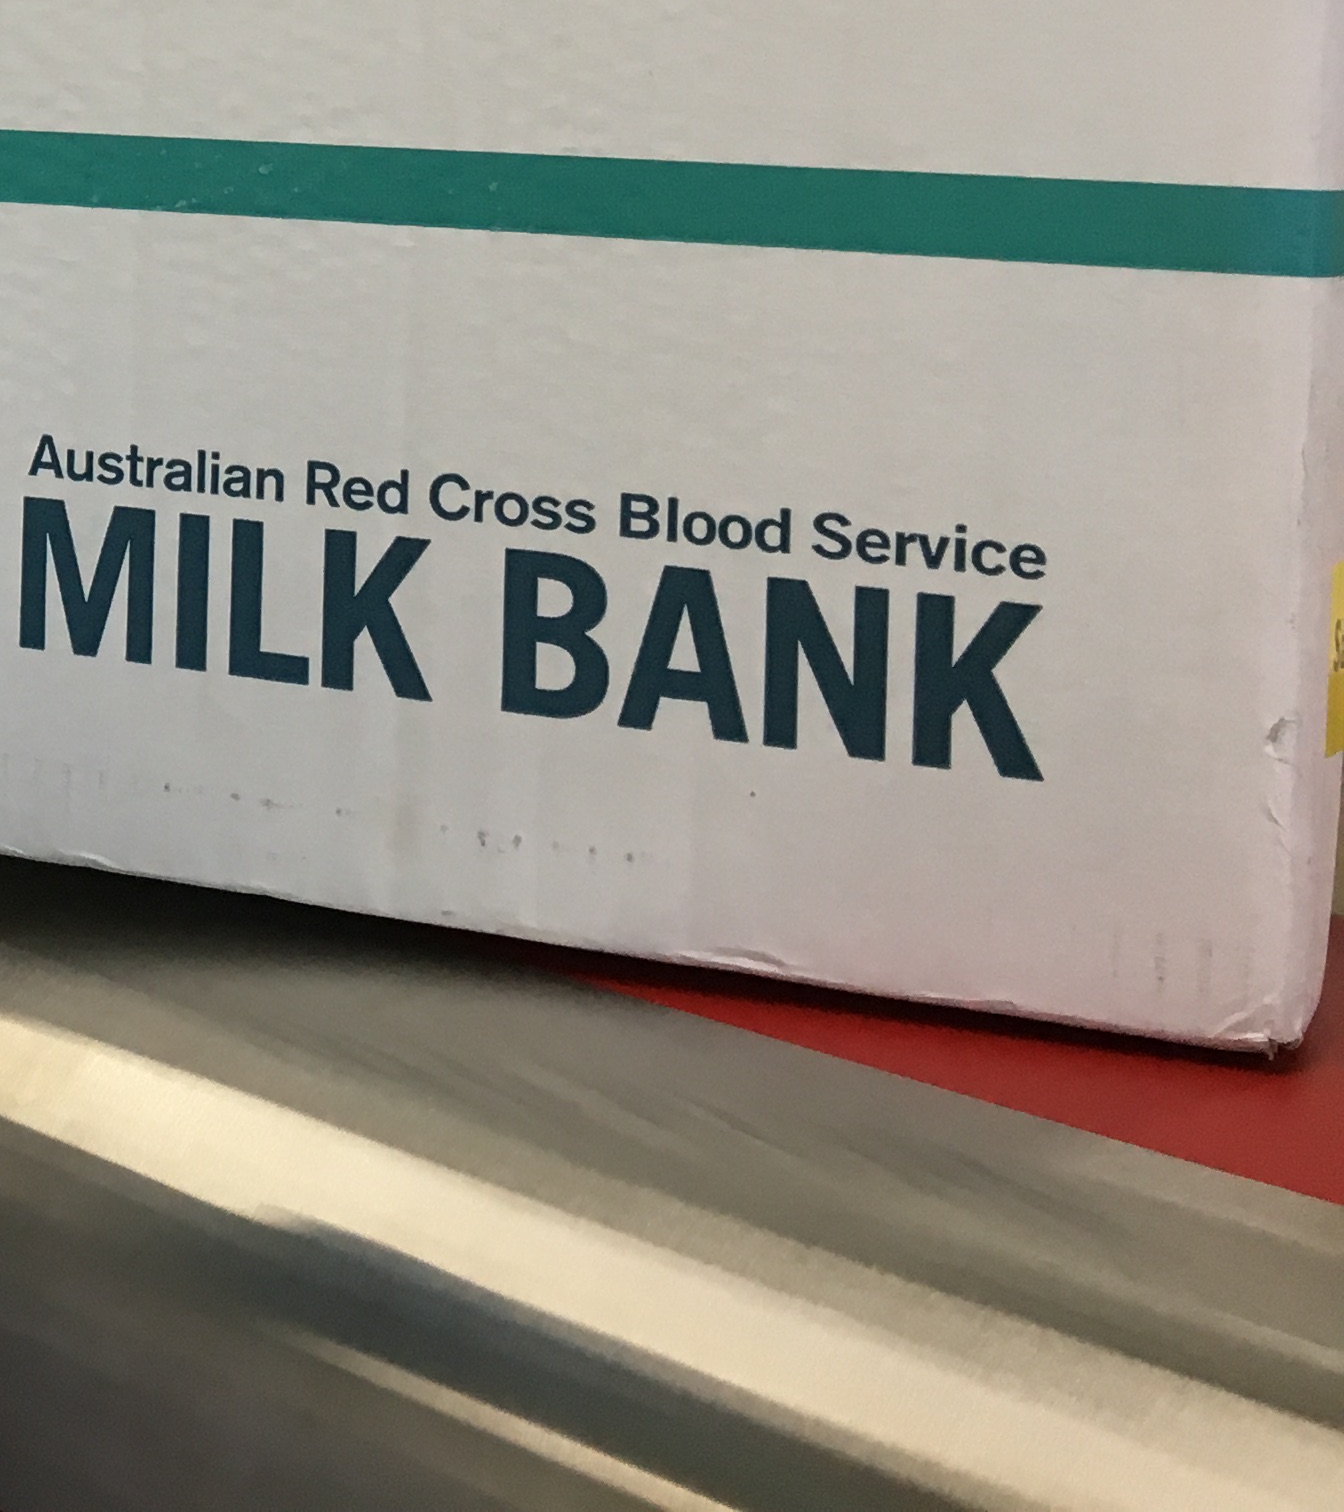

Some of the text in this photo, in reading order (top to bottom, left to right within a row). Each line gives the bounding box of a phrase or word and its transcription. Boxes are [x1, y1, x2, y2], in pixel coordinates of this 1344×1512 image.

[28, 435, 1047, 580] Australian Red Cross Blood Service
[19, 496, 1044, 782] MILK BANK
